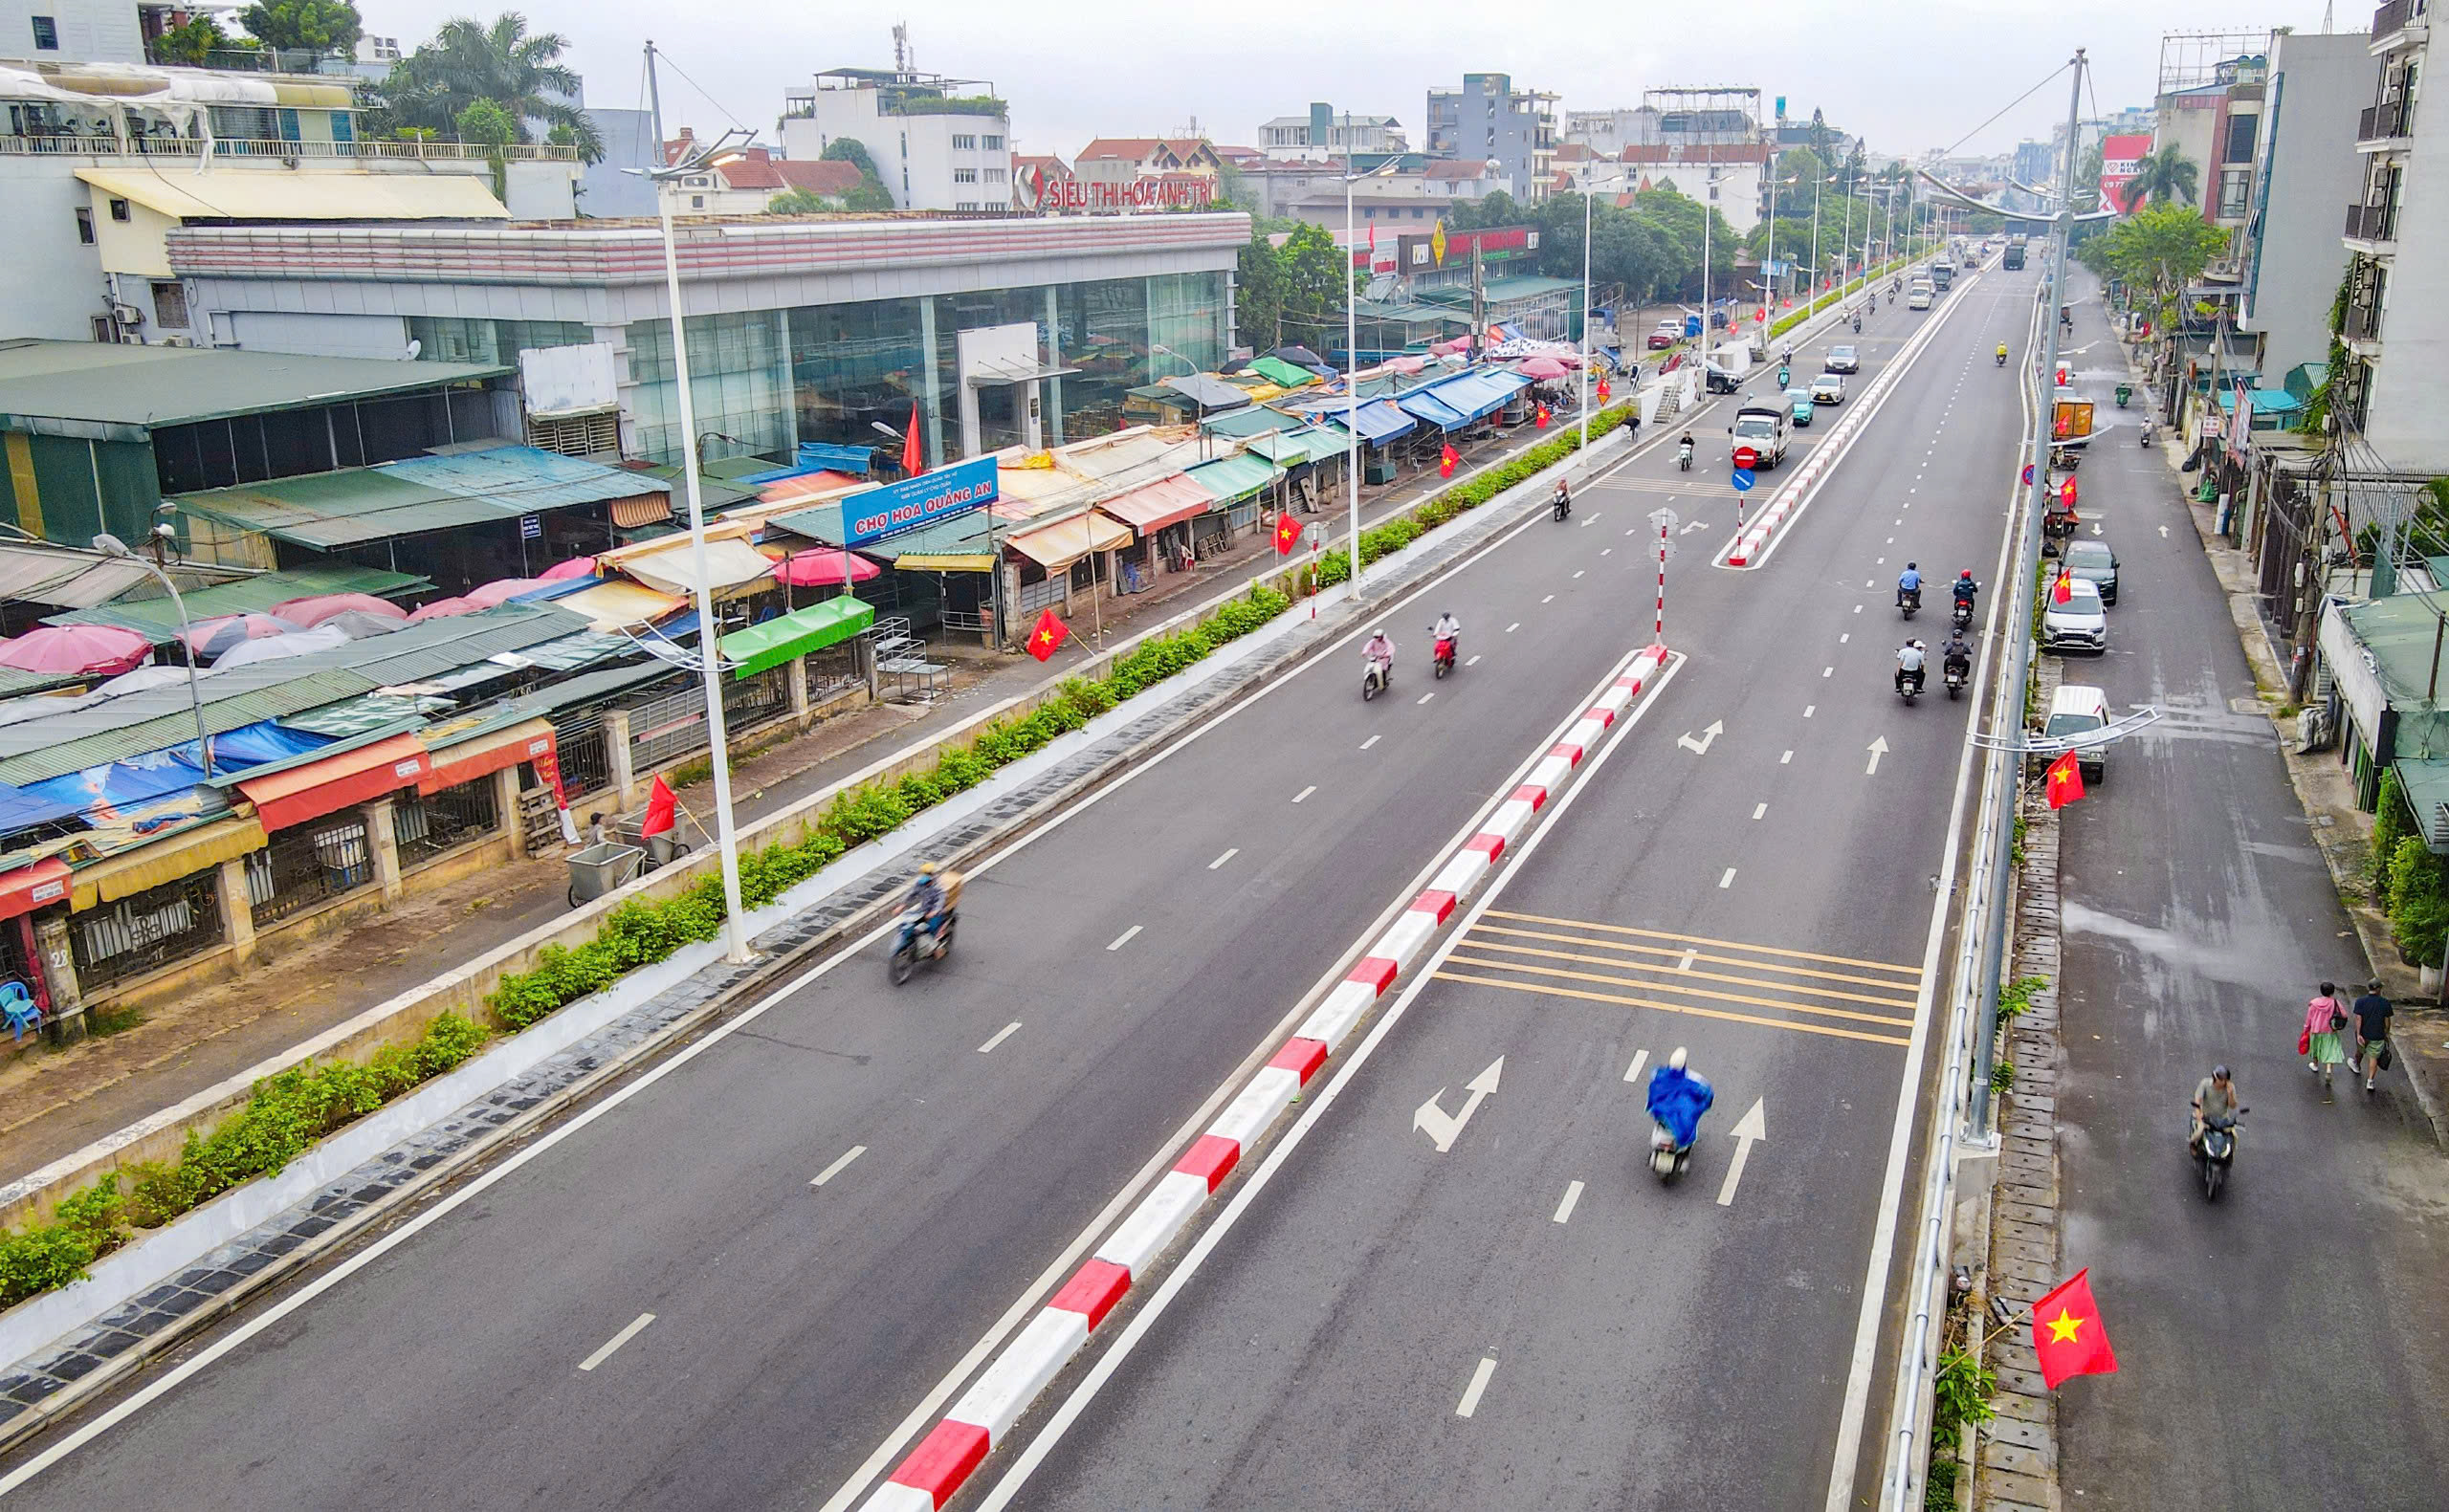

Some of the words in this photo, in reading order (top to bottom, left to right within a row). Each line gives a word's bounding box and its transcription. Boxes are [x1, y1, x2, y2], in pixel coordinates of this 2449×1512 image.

[855, 512, 888, 535] CHỢ
[892, 503, 922, 524] HOA
[925, 487, 972, 513] QUẢNG
[974, 480, 993, 498] AN
[52, 949, 68, 968] 28
